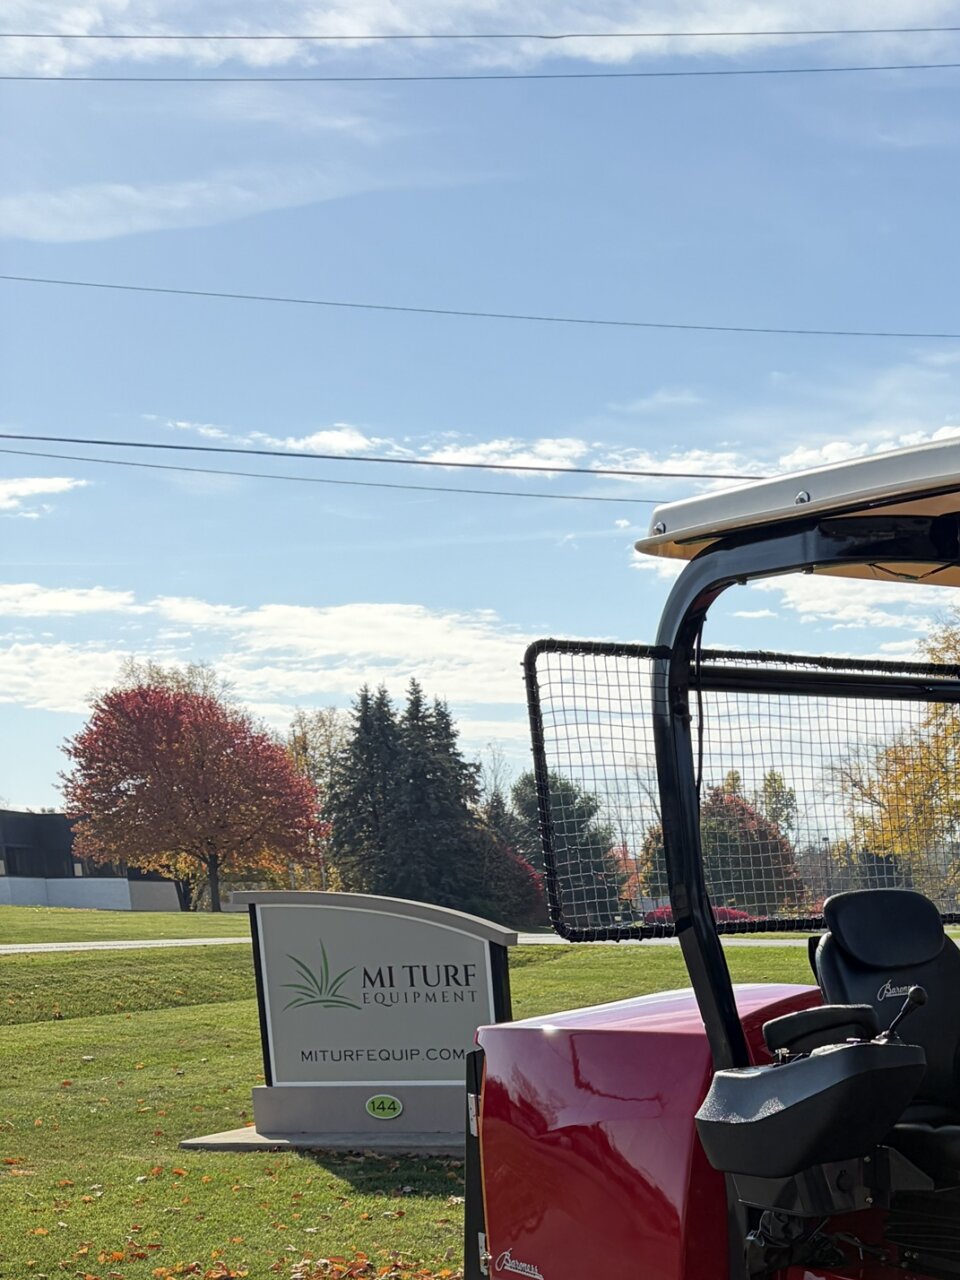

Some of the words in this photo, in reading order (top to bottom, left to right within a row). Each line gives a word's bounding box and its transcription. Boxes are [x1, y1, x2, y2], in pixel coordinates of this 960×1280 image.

[362, 965, 395, 989] MI
[401, 963, 477, 988] TURF
[362, 990, 479, 1008] EQUIPMENT
[301, 1048, 466, 1063] MITURFEQUIP.COM
[370, 1100, 398, 1113] 144
